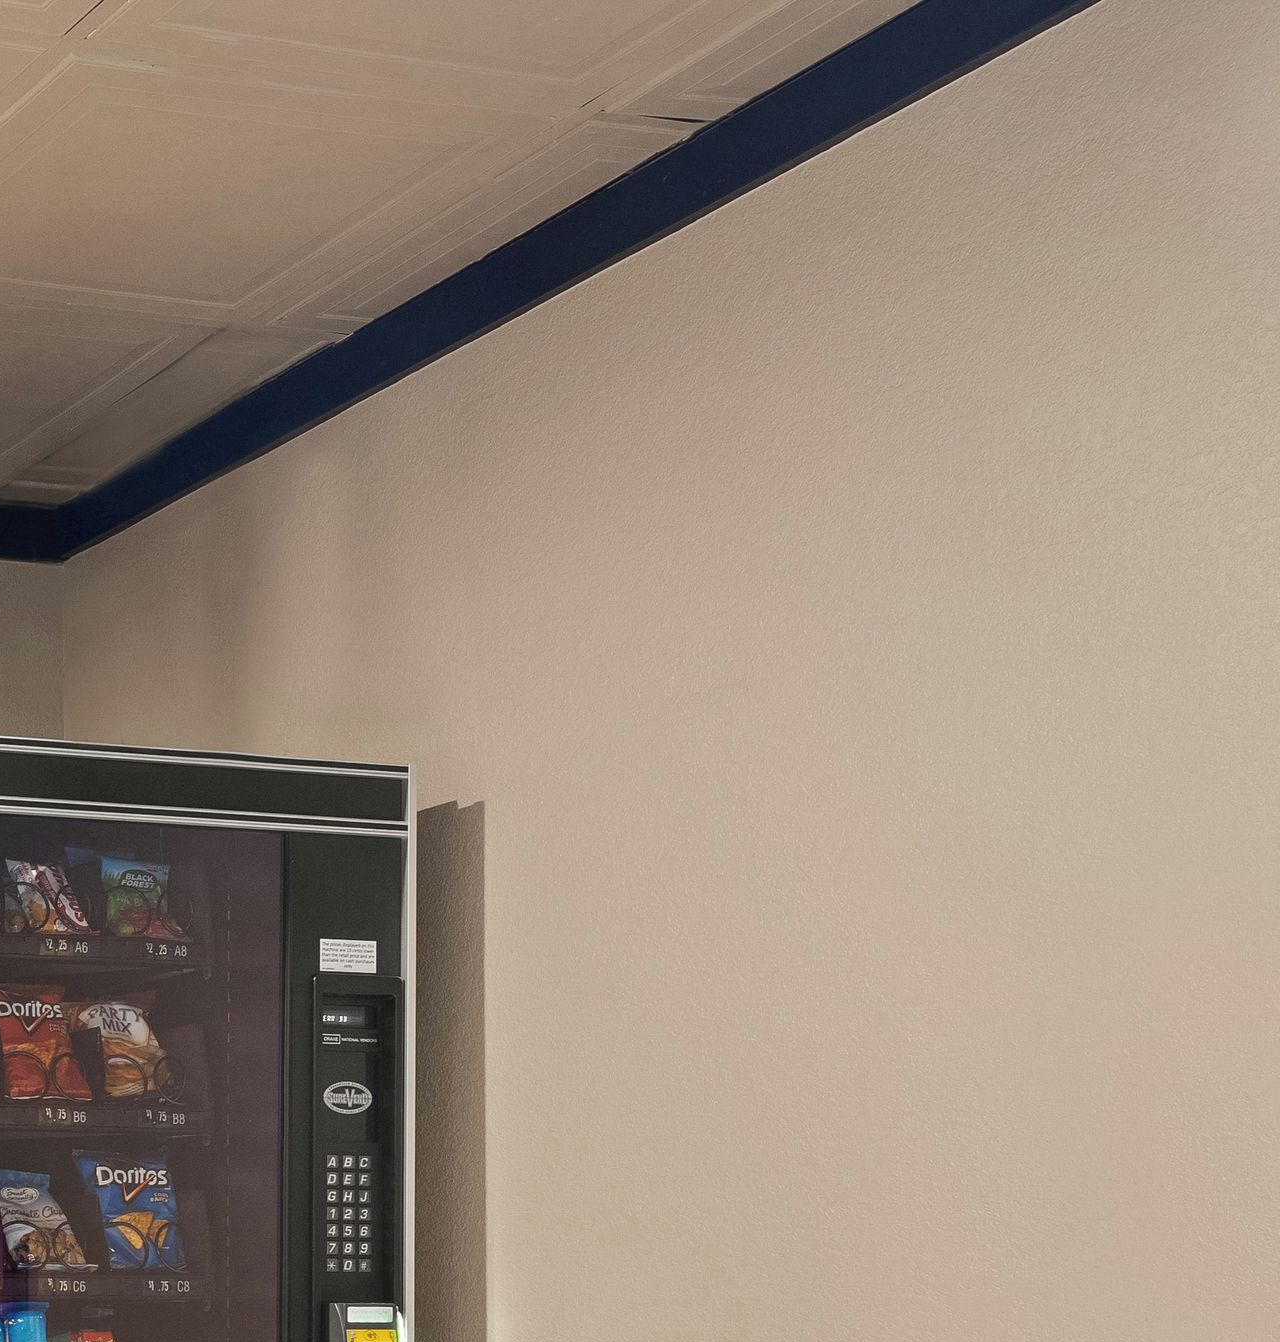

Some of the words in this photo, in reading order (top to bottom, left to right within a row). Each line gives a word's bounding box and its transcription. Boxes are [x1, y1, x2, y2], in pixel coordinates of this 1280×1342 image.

[125, 872, 154, 883] BLACK
[121, 879, 156, 889] FOREST
[46, 938, 68, 952] $2.25
[74, 942, 89, 953] A6
[146, 943, 168, 955] $2.25
[174, 945, 188, 957] A8
[88, 1006, 144, 1022] PARTY
[102, 1018, 132, 1036] MIX
[73, 1111, 87, 1123] B6
[172, 1113, 186, 1125] B8
[327, 1157, 337, 1167] A
[343, 1157, 353, 1167] B
[359, 1157, 369, 1168] C
[96, 1165, 169, 1187] Doritos
[327, 1174, 337, 1184] D
[343, 1174, 353, 1185] E
[359, 1175, 369, 1185] F
[327, 1191, 337, 1201] G
[343, 1192, 353, 1202] H
[359, 1192, 368, 1202] J
[329, 1208, 336, 1219] 1
[343, 1208, 353, 1219] 2
[359, 1209, 368, 1219] 3
[327, 1226, 337, 1236] 4
[343, 1226, 353, 1236] 5
[360, 1226, 368, 1237] 6
[328, 1243, 337, 1253] 7
[344, 1243, 353, 1253] 8
[360, 1243, 368, 1254] 9
[72, 1280, 86, 1293] C6
[177, 1280, 190, 1293] C8
